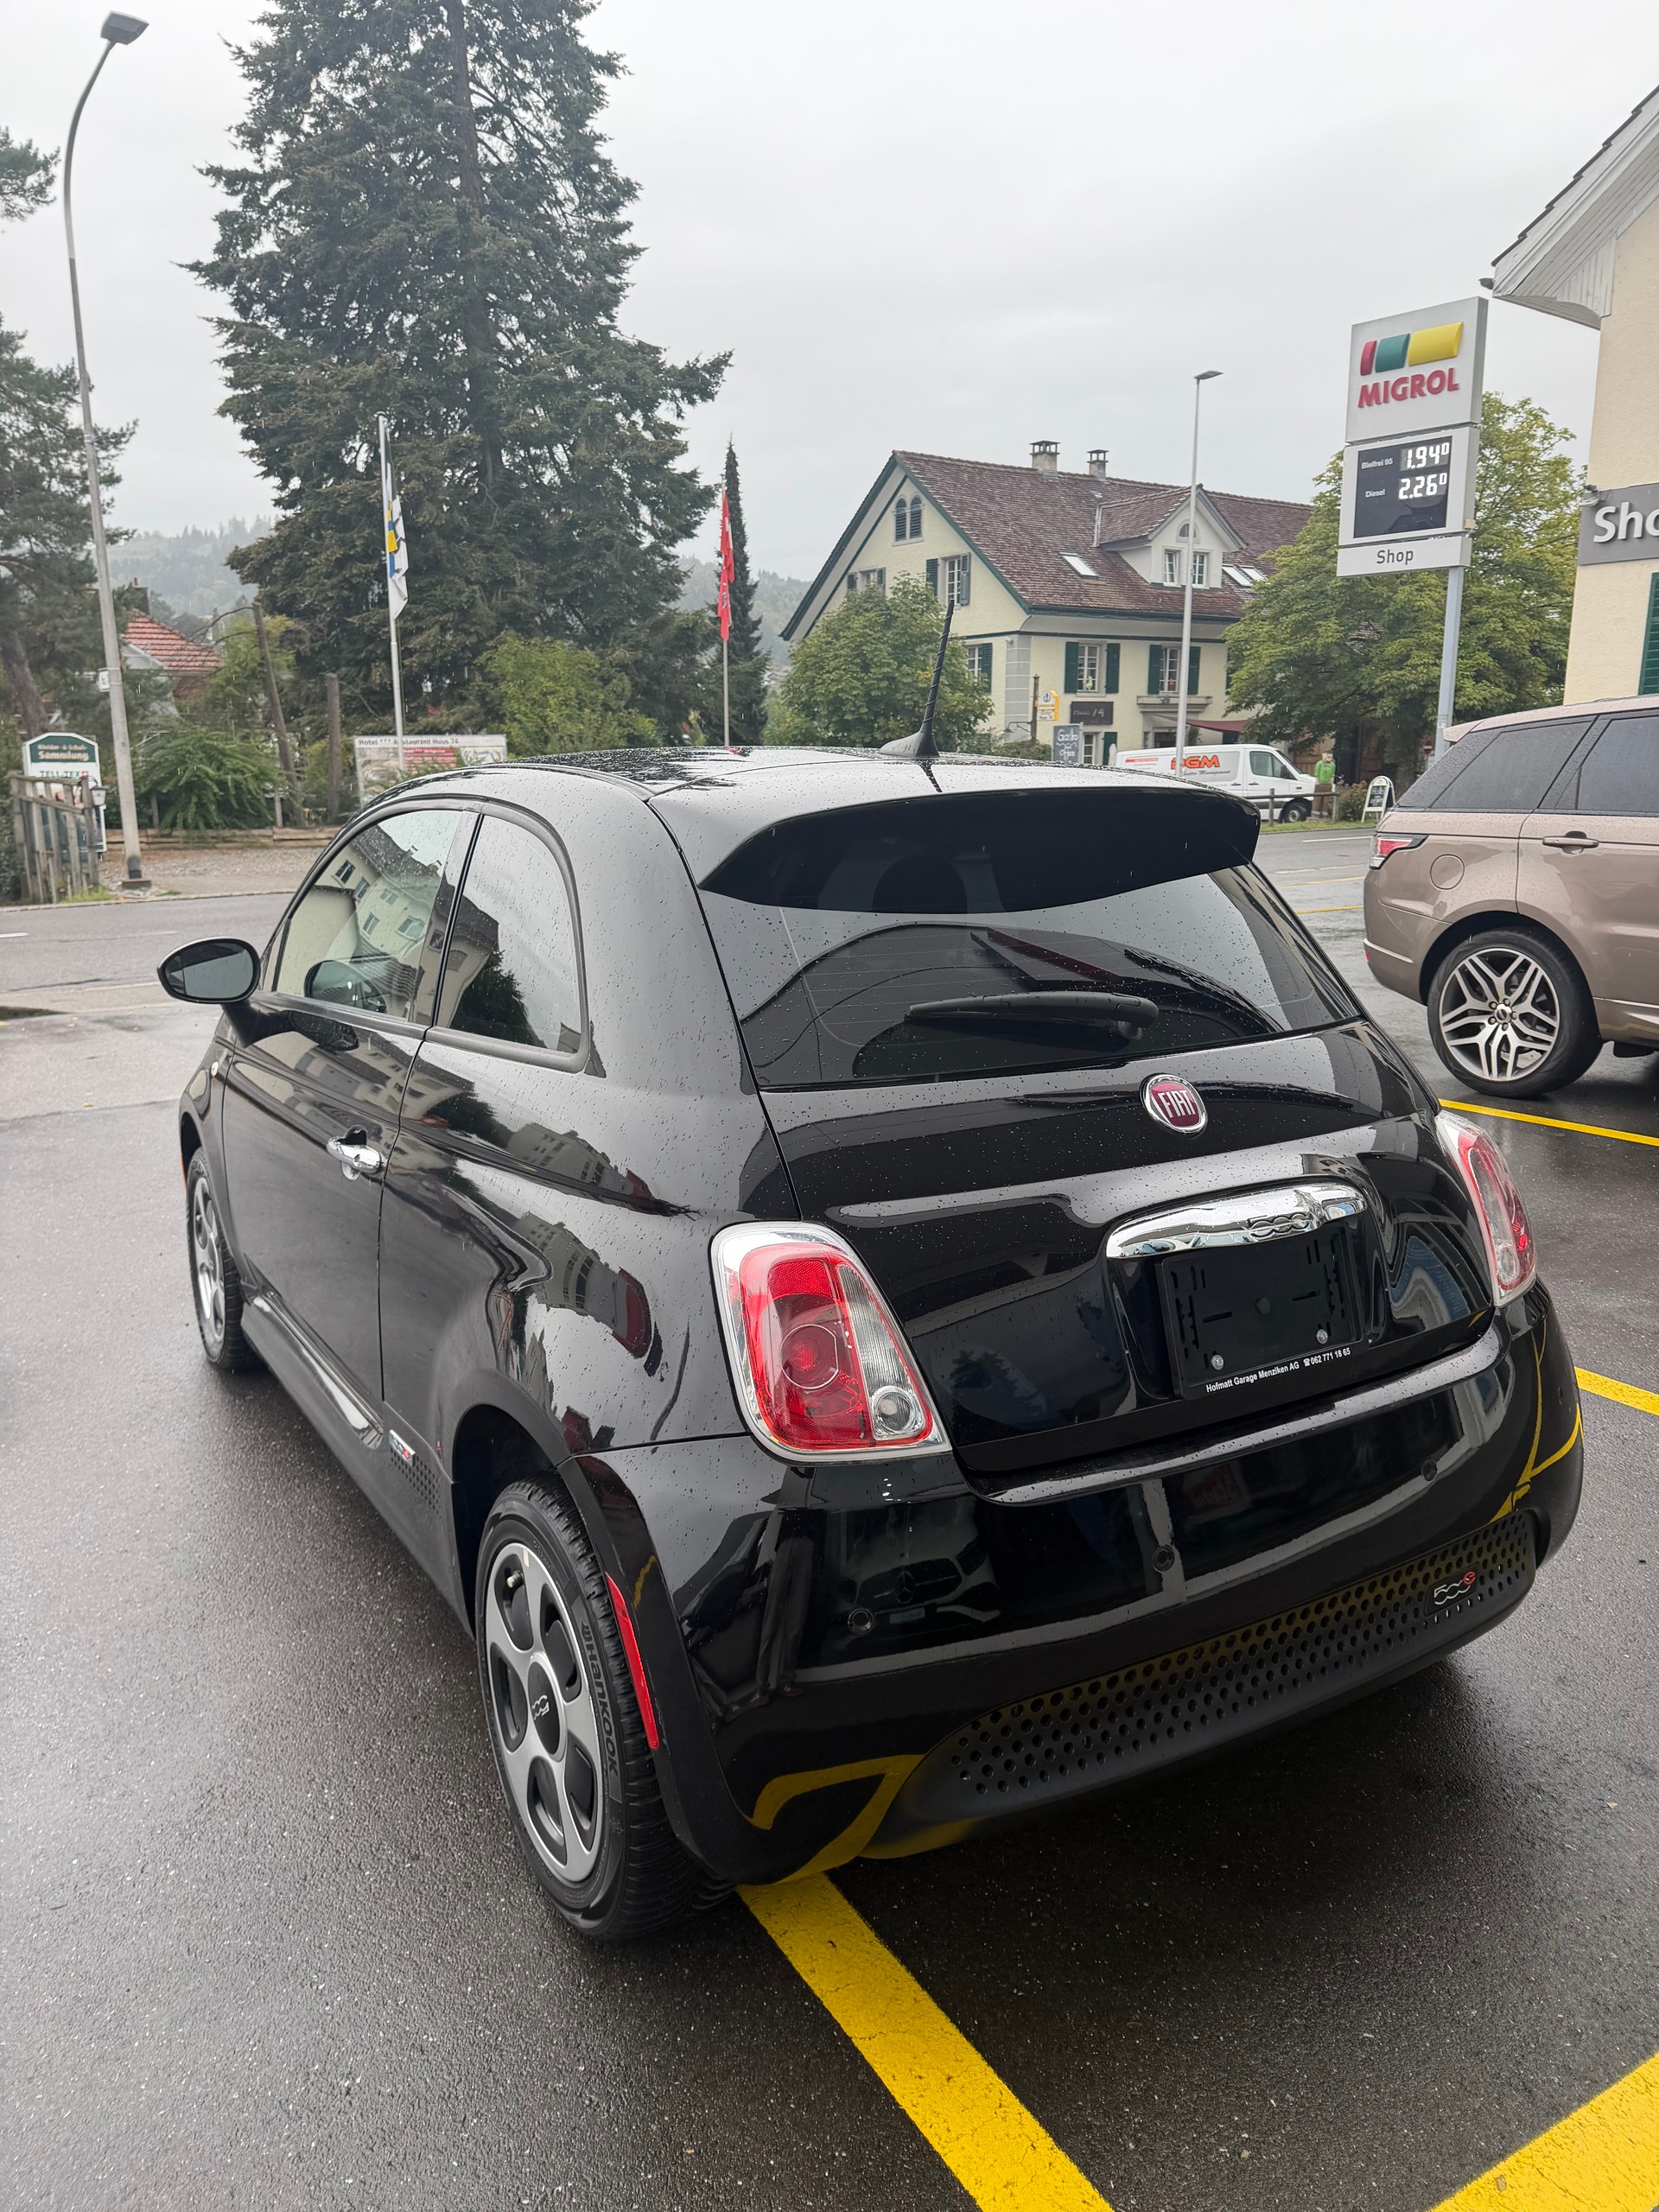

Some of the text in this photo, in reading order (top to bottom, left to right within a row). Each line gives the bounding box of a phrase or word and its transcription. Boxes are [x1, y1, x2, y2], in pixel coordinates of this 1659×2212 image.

[1357, 367, 1460, 409] MIGROL
[1361, 457, 1394, 469] Bleifrei 95
[1365, 488, 1386, 498] Diesel
[1376, 549, 1414, 565] Shop
[38, 751, 89, 761] Sammlung
[1158, 1090, 1196, 1118] FIAT
[1247, 1211, 1310, 1237] 500
[1206, 1347, 1351, 1393] Hofmatt Garage Menziken AG 062 771 18 65
